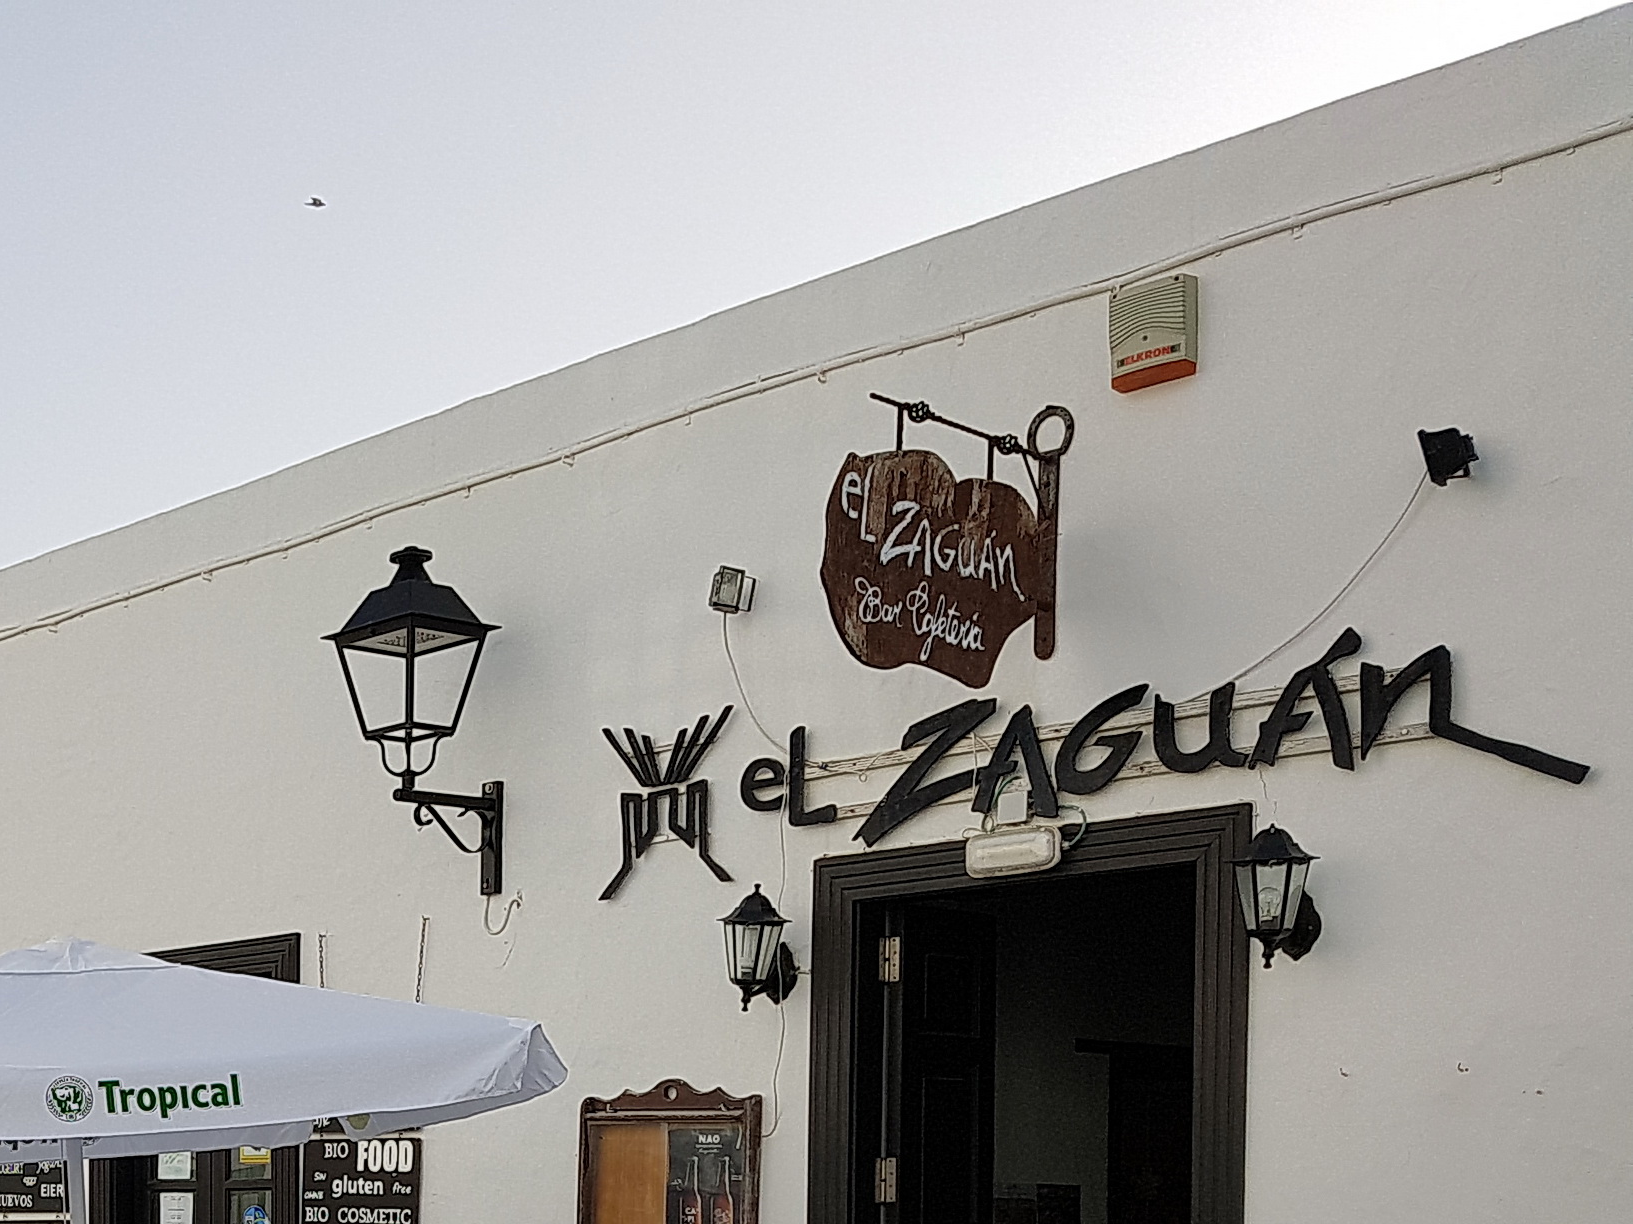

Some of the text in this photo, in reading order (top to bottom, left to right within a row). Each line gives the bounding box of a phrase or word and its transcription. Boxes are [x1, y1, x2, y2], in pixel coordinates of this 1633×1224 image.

[1124, 345, 1171, 366] ELKRON
[854, 576, 903, 628] Bar
[98, 1073, 242, 1119] Tropical
[698, 1134, 721, 1144] NAO
[324, 1139, 414, 1173] BIO FOOD
[40, 1183, 63, 1198] EIER
[332, 1174, 384, 1198] gluten
[392, 1181, 412, 1195] free
[305, 1206, 412, 1224] BIO COSMETIC
